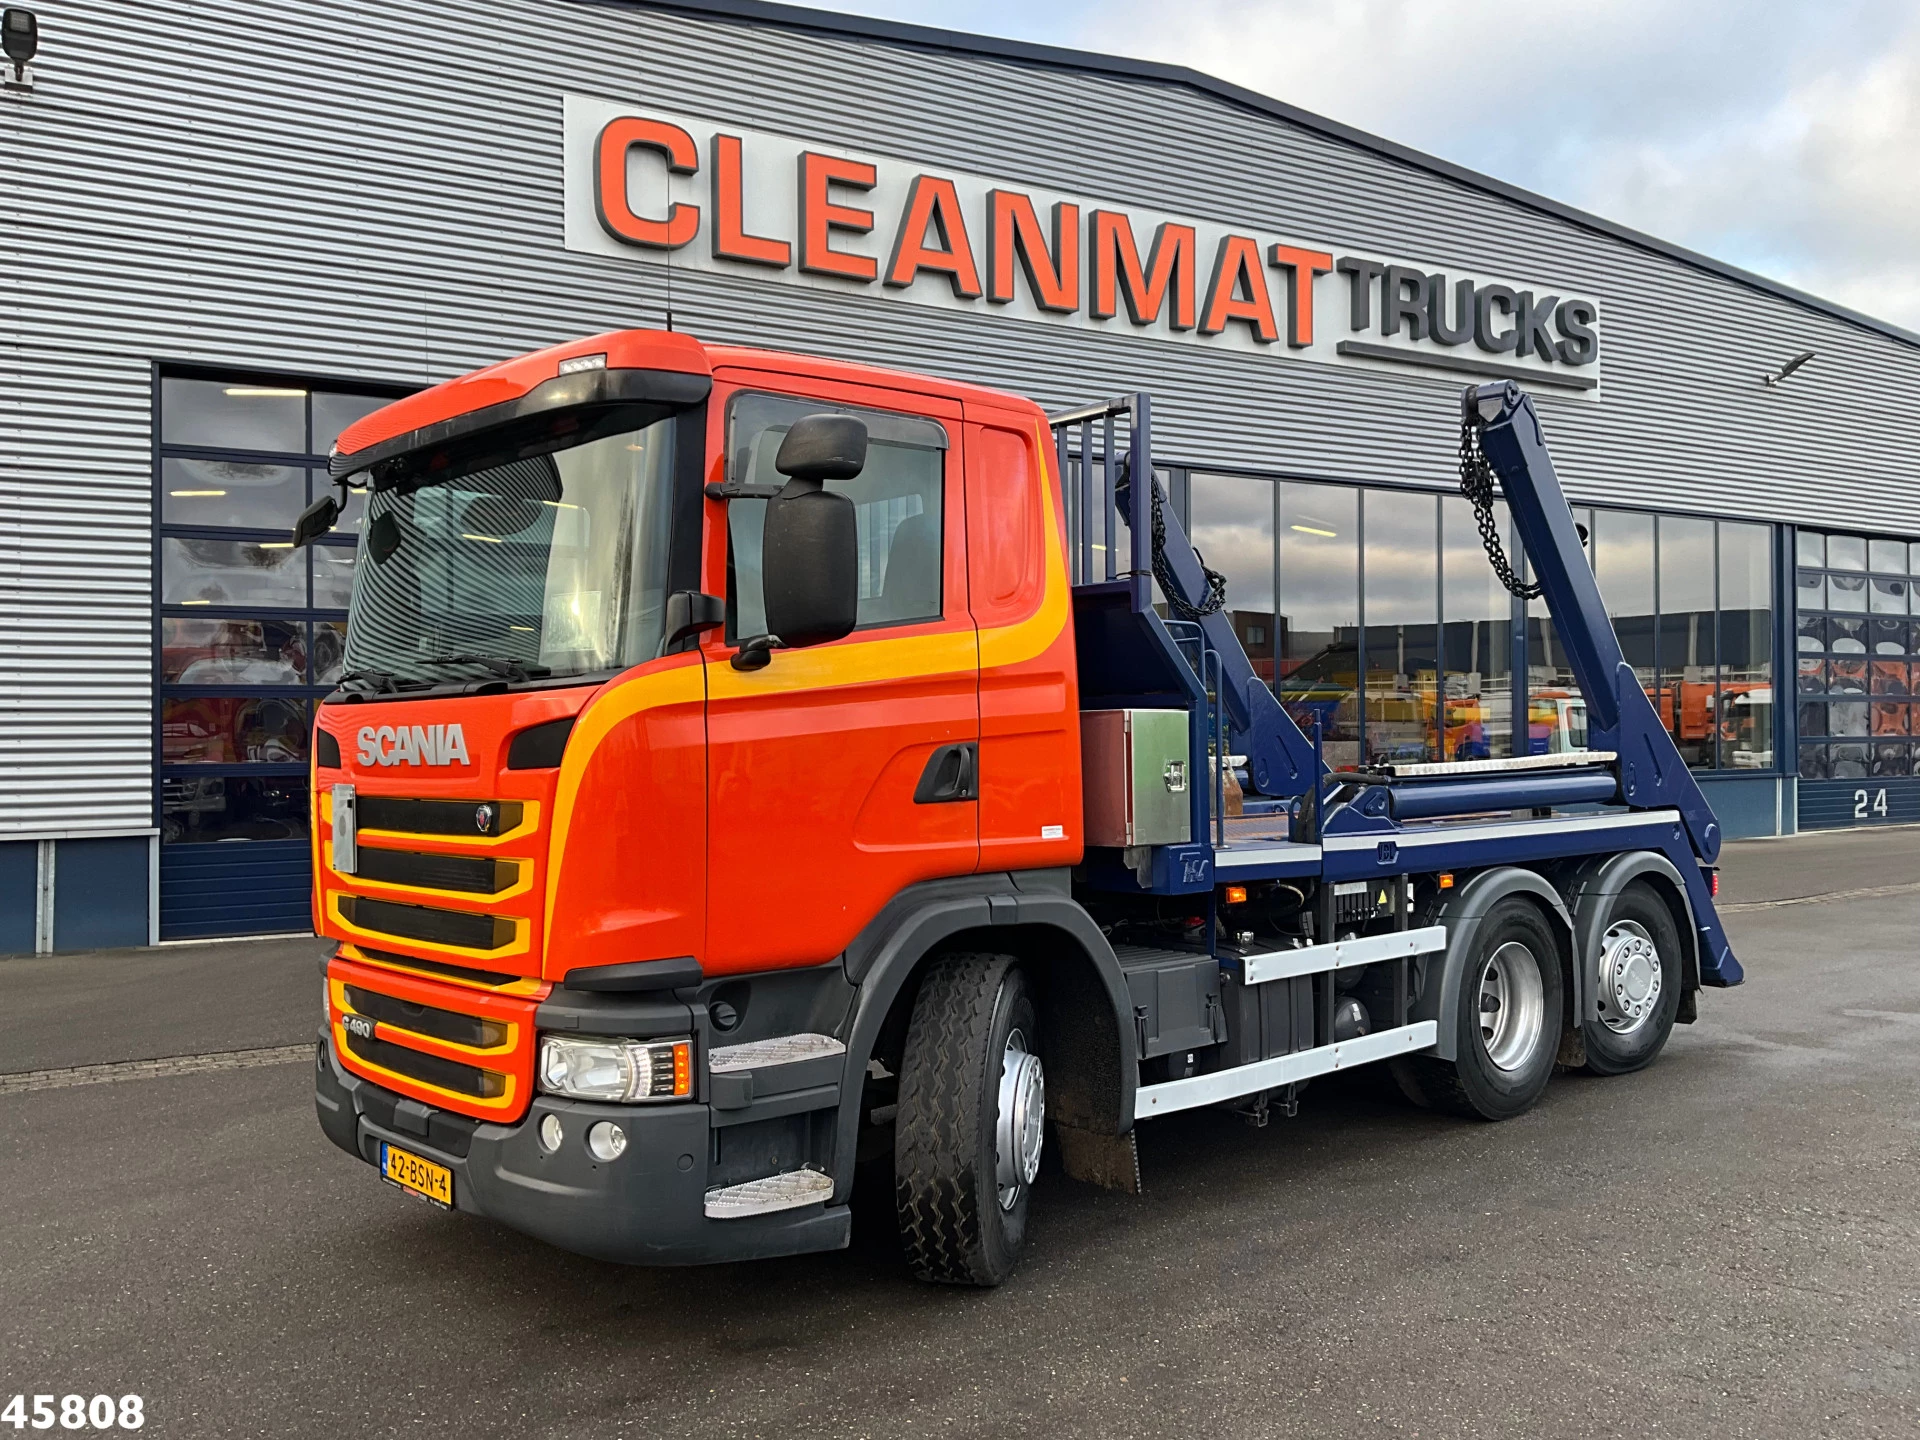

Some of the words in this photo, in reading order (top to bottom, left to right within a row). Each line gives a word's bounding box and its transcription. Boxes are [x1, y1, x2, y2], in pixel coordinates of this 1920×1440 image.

[593, 115, 1334, 349] CLEANMAT
[1336, 256, 1598, 366] TRUCKS
[357, 723, 470, 766] SCANIA
[1854, 788, 1888, 818] 24
[390, 1152, 447, 1198] 42-BSN-4
